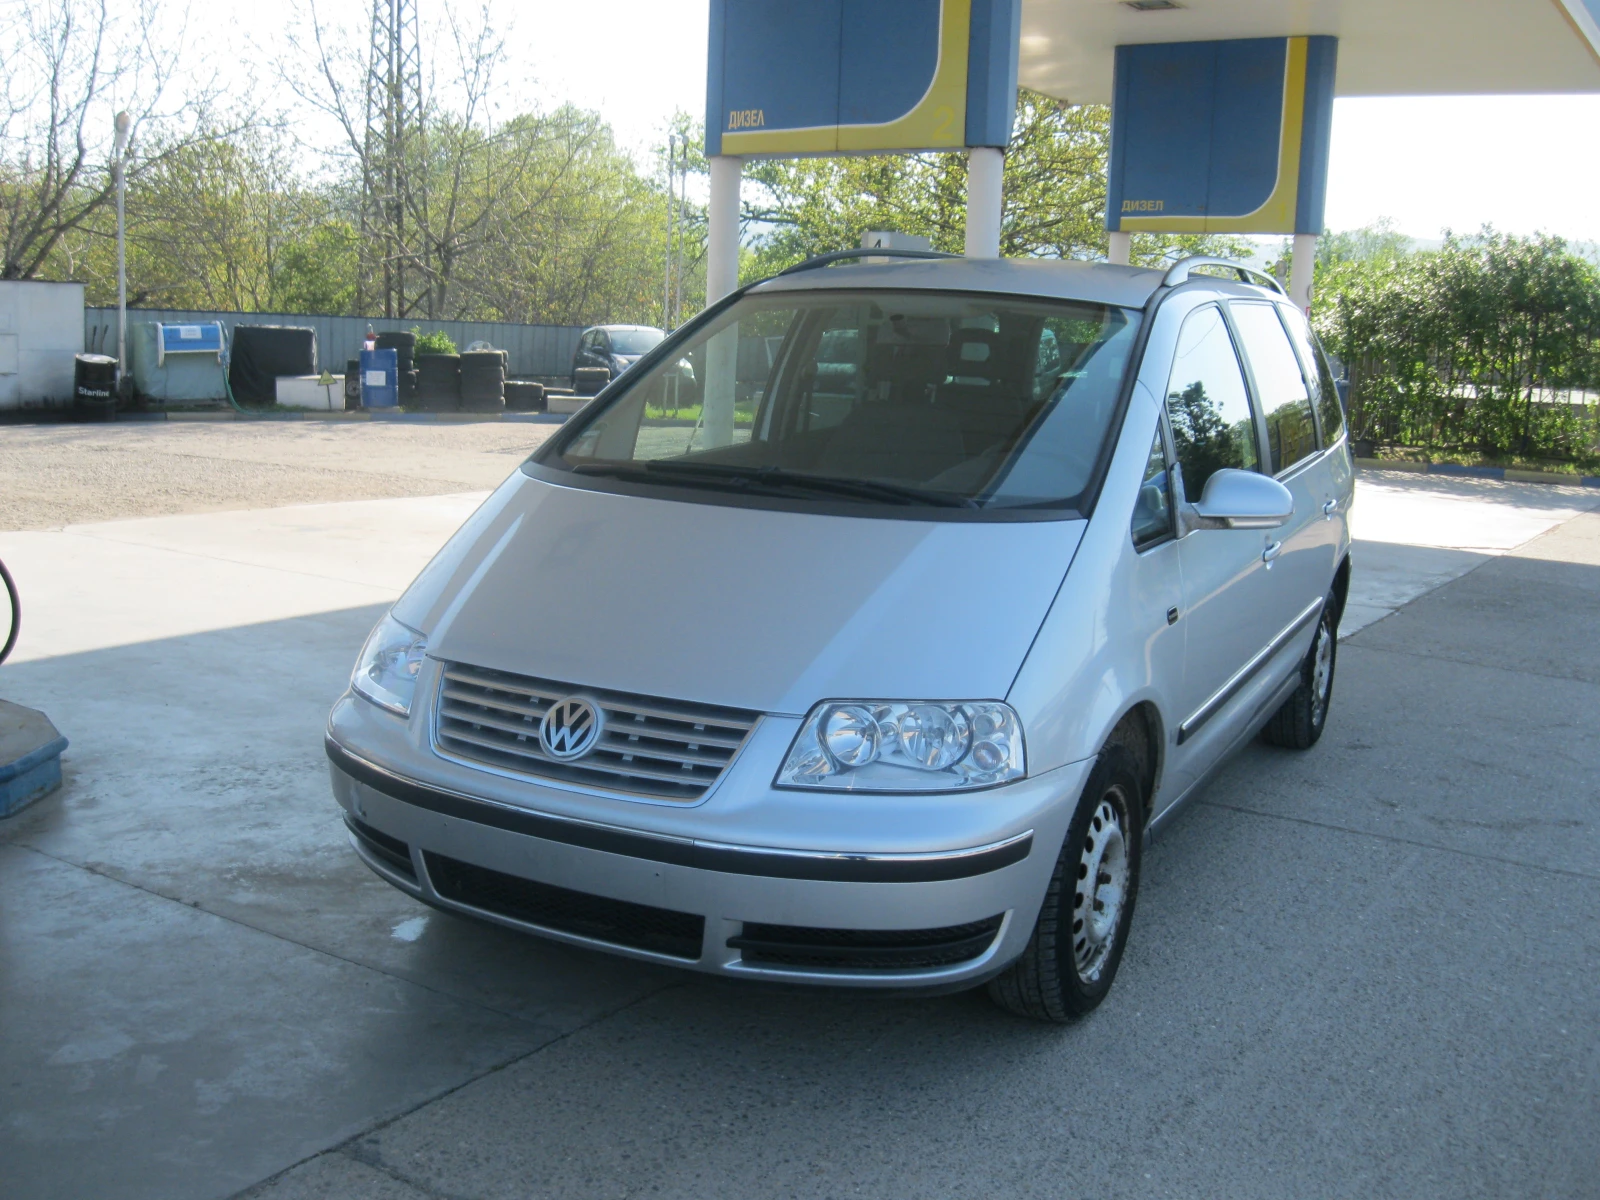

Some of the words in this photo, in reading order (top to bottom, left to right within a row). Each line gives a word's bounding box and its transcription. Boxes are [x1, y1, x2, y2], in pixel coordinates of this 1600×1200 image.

[728, 109, 765, 130] ДИЗЕЛ
[932, 106, 955, 140] 2
[1121, 199, 1164, 213] ДИЗЕЛ
[78, 386, 110, 399] Starline
